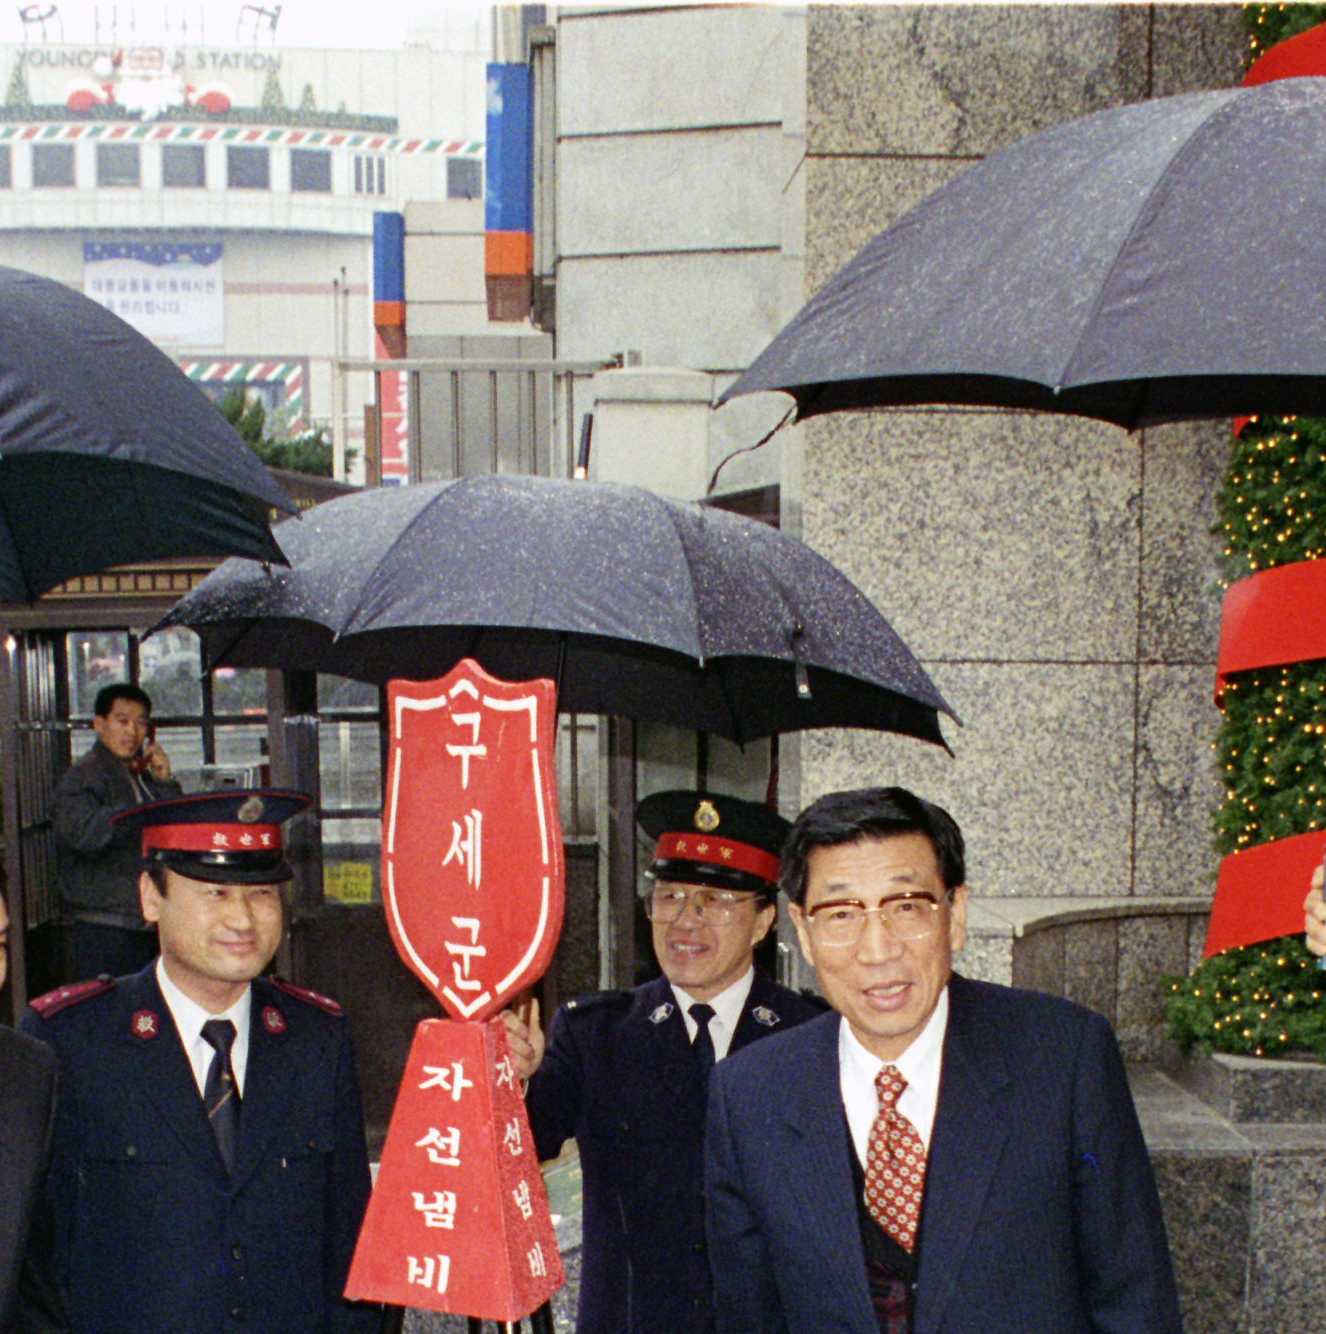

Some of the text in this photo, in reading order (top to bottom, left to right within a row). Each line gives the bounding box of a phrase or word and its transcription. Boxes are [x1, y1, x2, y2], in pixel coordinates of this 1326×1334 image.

[197, 51, 282, 71] STATION
[441, 711, 486, 991] 구세군
[406, 1063, 473, 1294] 자선냄비
[496, 1054, 548, 1280] 자선냄비
